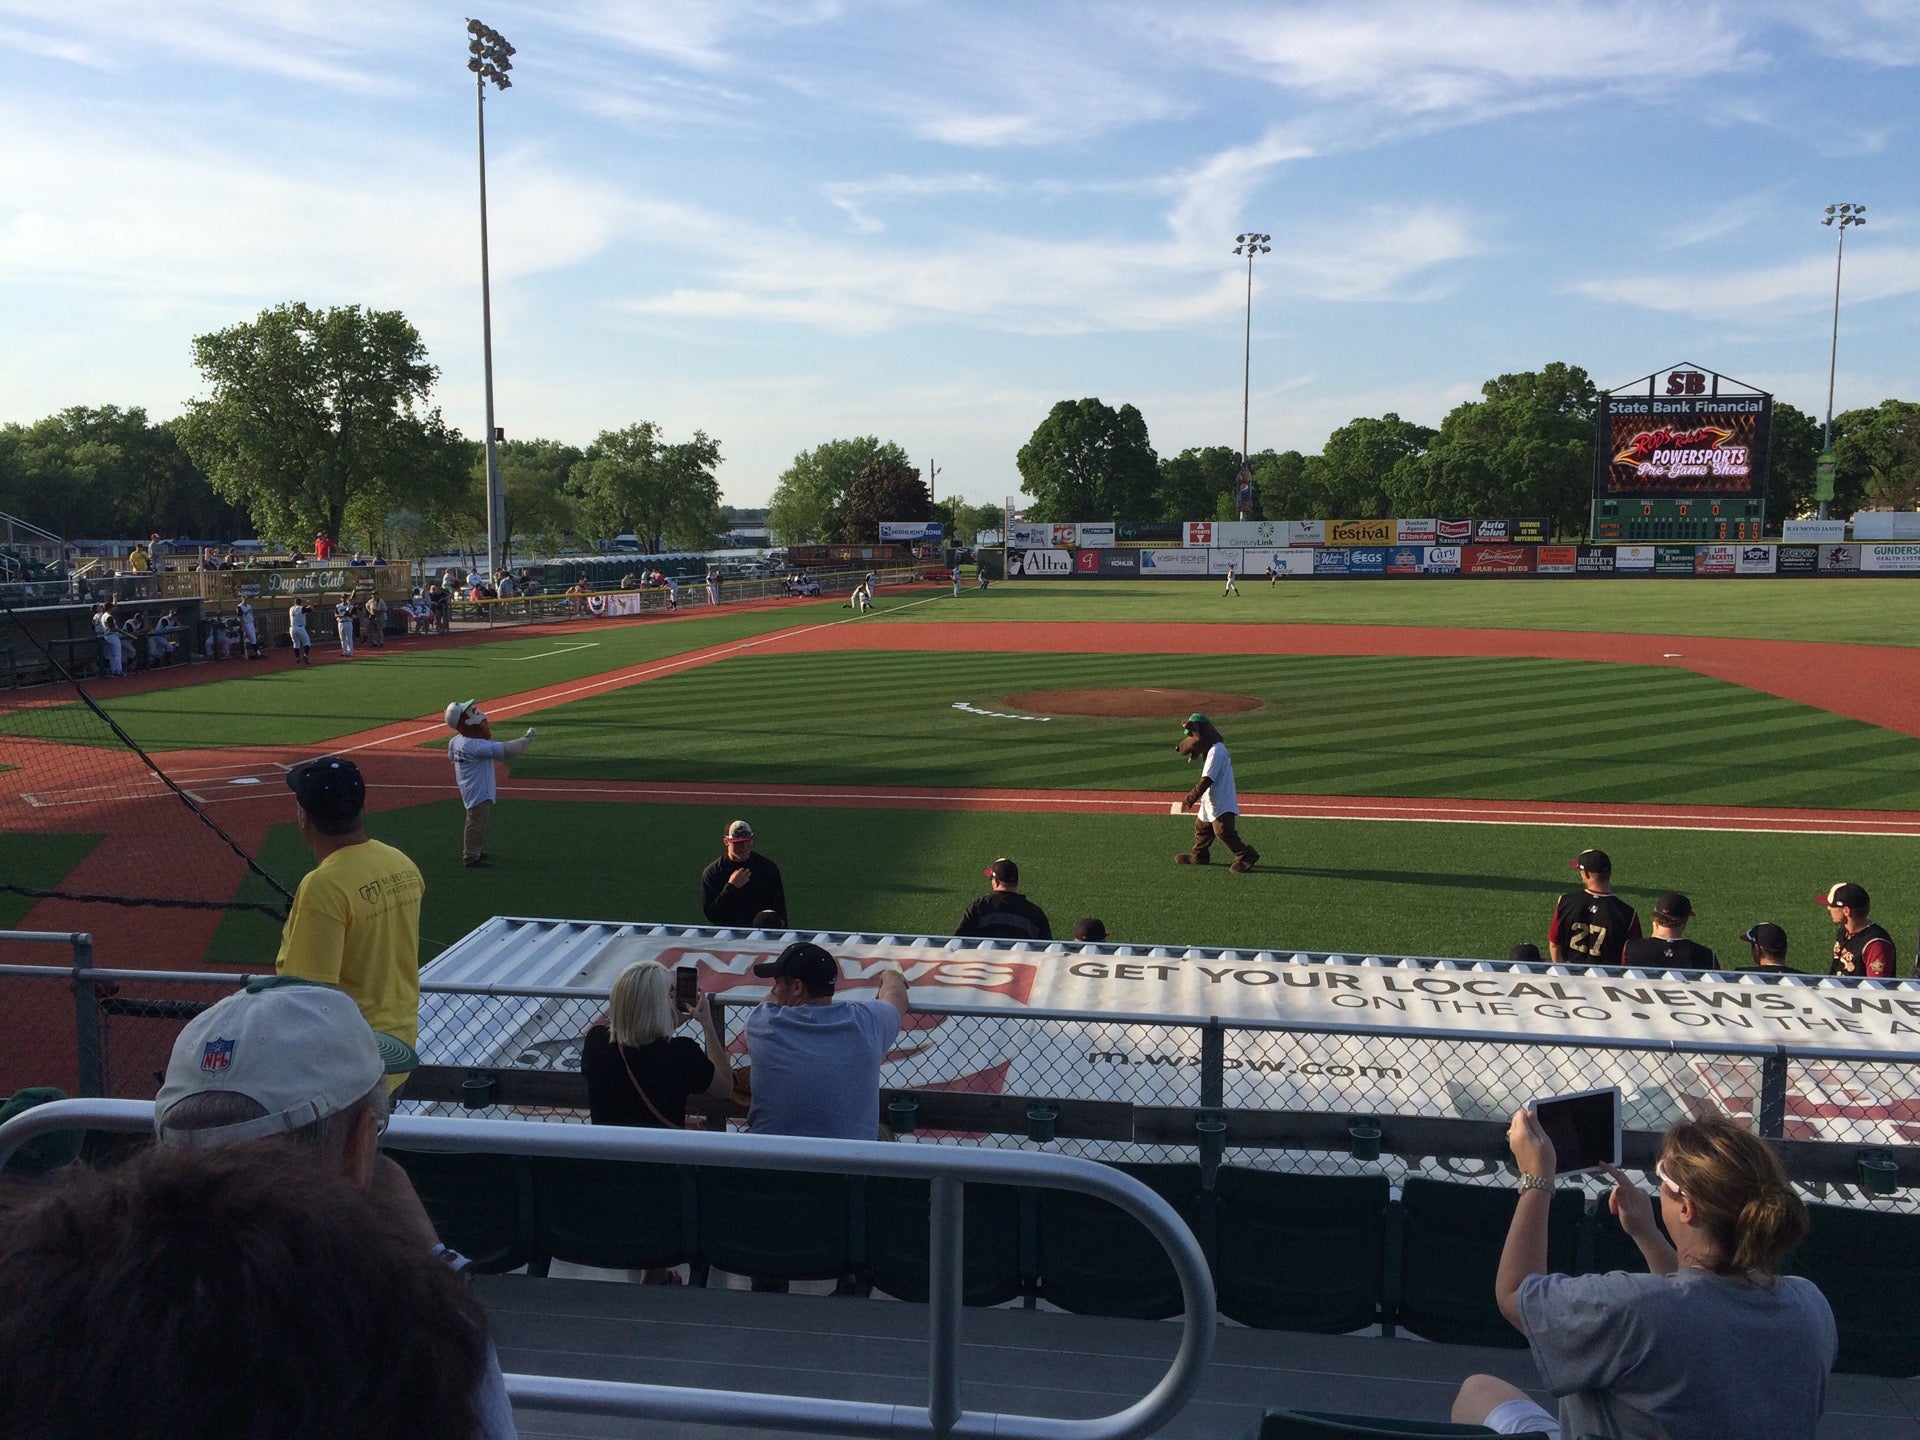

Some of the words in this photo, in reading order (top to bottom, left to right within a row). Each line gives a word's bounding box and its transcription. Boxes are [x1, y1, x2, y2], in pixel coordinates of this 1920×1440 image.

[1666, 372, 1706, 395] SB
[1609, 402, 1649, 414] State
[1653, 401, 1690, 413] Bank
[1695, 400, 1763, 412] Financial
[1652, 449, 1746, 465] POWERSPORTS
[1637, 462, 1708, 478] Pre-Game
[1712, 461, 1749, 475] Show
[1643, 505, 1651, 516] 0
[1679, 505, 1687, 516] 0
[1712, 505, 1720, 516] 0
[1480, 520, 1505, 529] Auto
[1720, 522, 1727, 531] 0
[1739, 522, 1746, 531] 0
[1752, 522, 1759, 531] 0
[1332, 525, 1389, 541] festival
[1478, 528, 1506, 537] Value
[1719, 530, 1726, 539] 0
[1738, 530, 1745, 539] 0
[1752, 530, 1759, 539] 0
[1229, 539, 1274, 547] CenturyLink
[1873, 546, 1920, 555] GUNDERS
[1027, 551, 1069, 570] Altra
[1361, 553, 1383, 563] EGS
[1429, 548, 1456, 564] Cary
[1589, 549, 1601, 557] JAY
[1577, 557, 1614, 565] BUCKLEY'S
[1471, 565, 1492, 573] GRAB
[268, 572, 316, 593] Dugout
[318, 569, 345, 589] Club
[1569, 922, 1607, 956] 27
[672, 951, 1014, 987] NWS
[1069, 962, 1180, 981] GET
[1196, 966, 1363, 991] YOUR
[1383, 975, 1586, 1000] LOCAL
[1600, 985, 1813, 1015] NEWS.
[1331, 994, 1407, 1011] ON
[1421, 998, 1518, 1016] THE
[1534, 1004, 1613, 1021] GO
[1670, 1012, 1754, 1029] ON
[1772, 1015, 1873, 1035] THE
[203, 1052, 231, 1071] NFL
